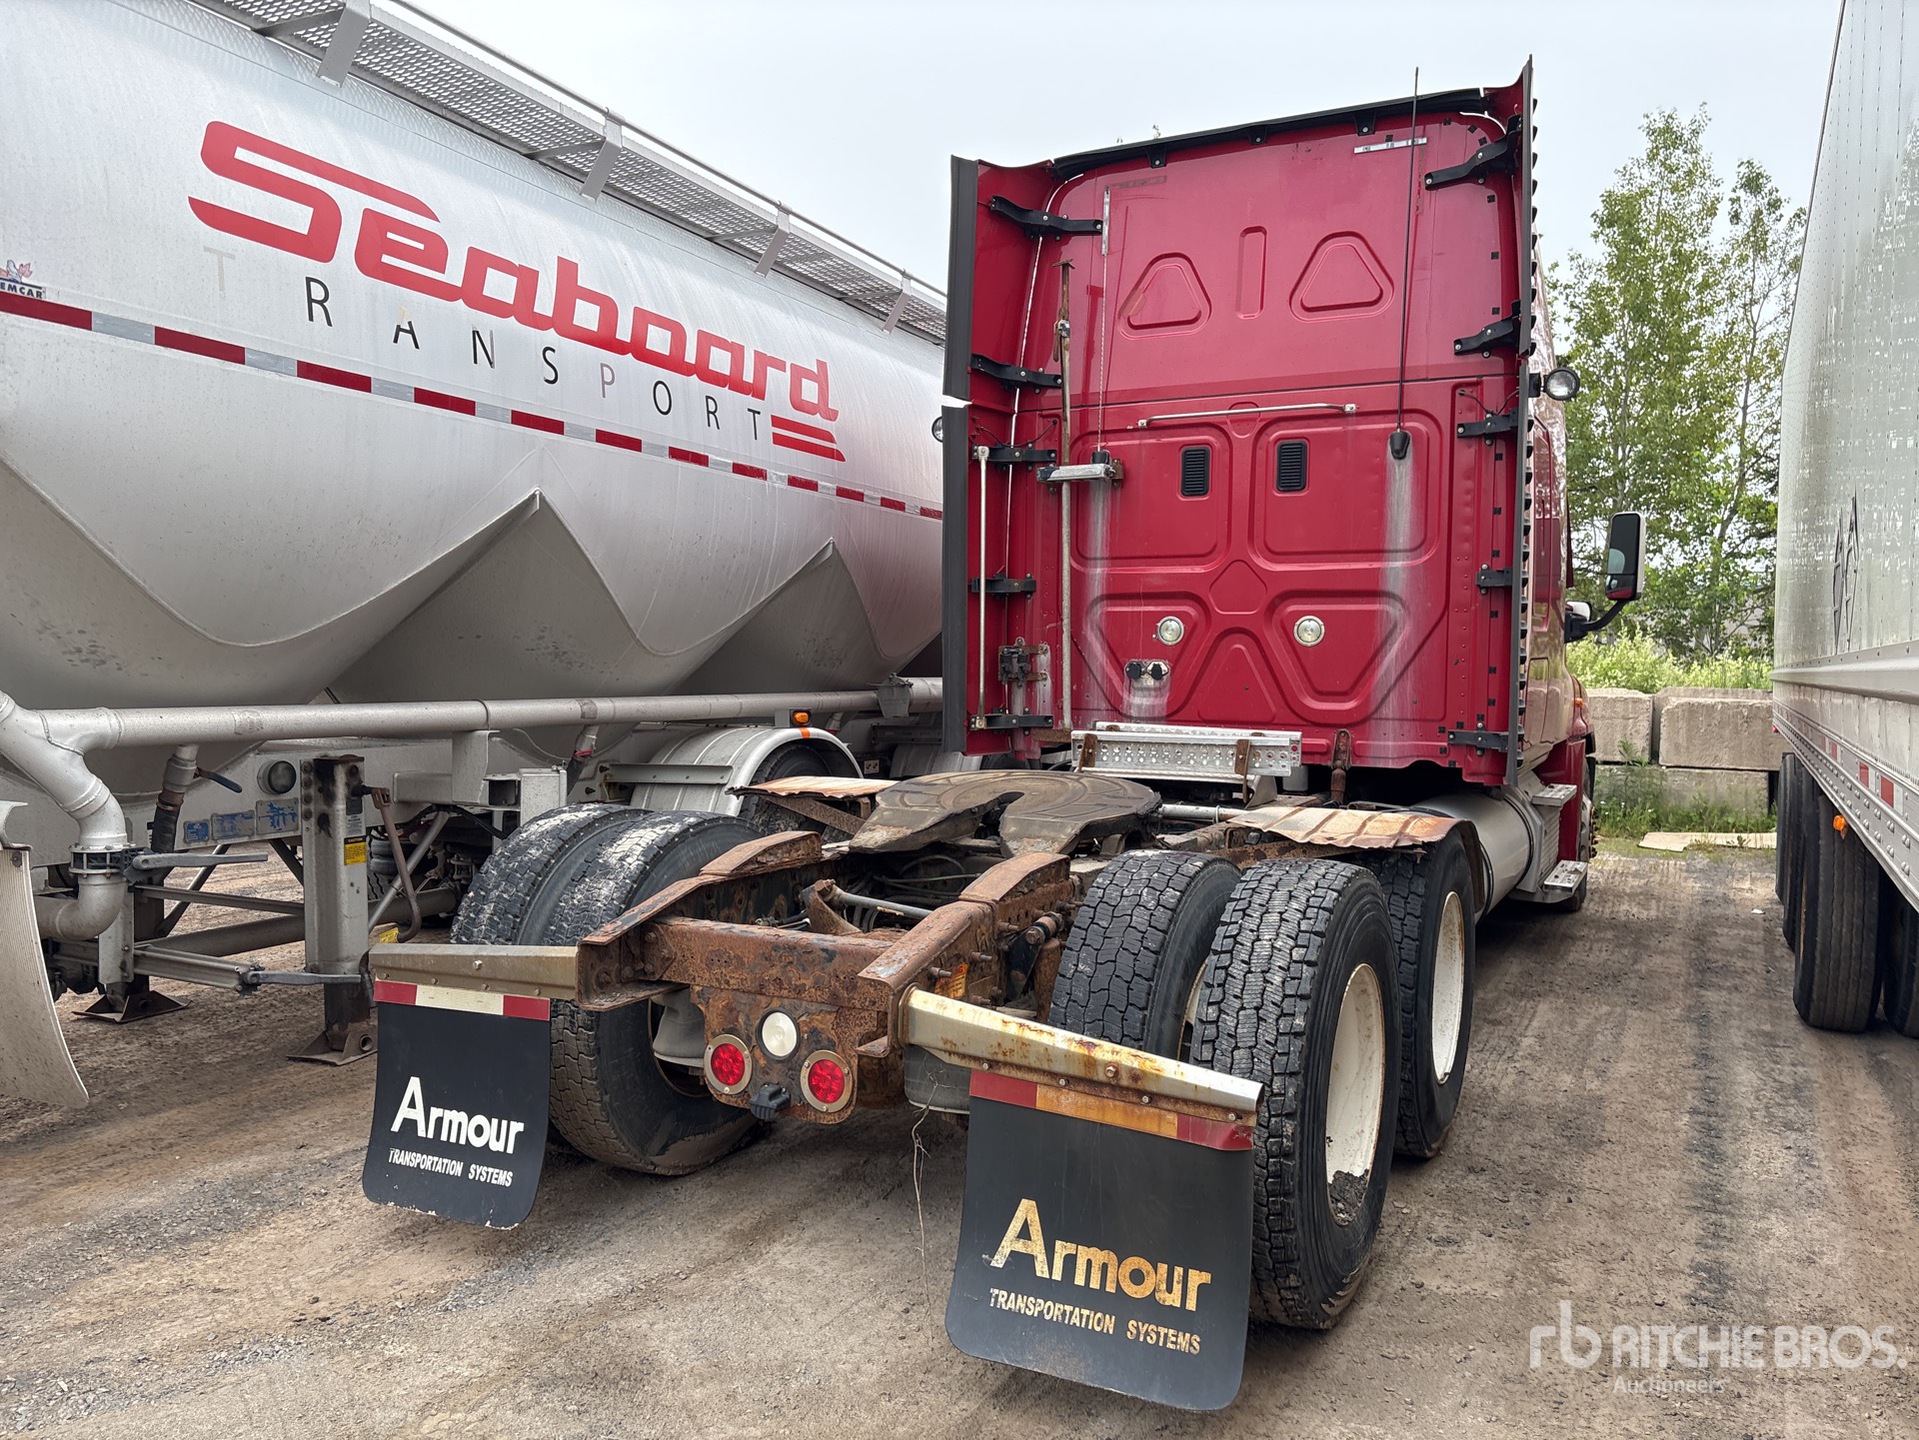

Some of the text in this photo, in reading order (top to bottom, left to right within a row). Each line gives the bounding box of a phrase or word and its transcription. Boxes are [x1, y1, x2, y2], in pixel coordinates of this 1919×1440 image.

[188, 121, 839, 421] Seaboard
[390, 1076, 525, 1154] Armour
[388, 1148, 513, 1187] TRANSPORTATION SYSTEMS
[990, 1198, 1212, 1312] Armour
[989, 1288, 1201, 1356] TRANSPORTATION SYSTEMS
